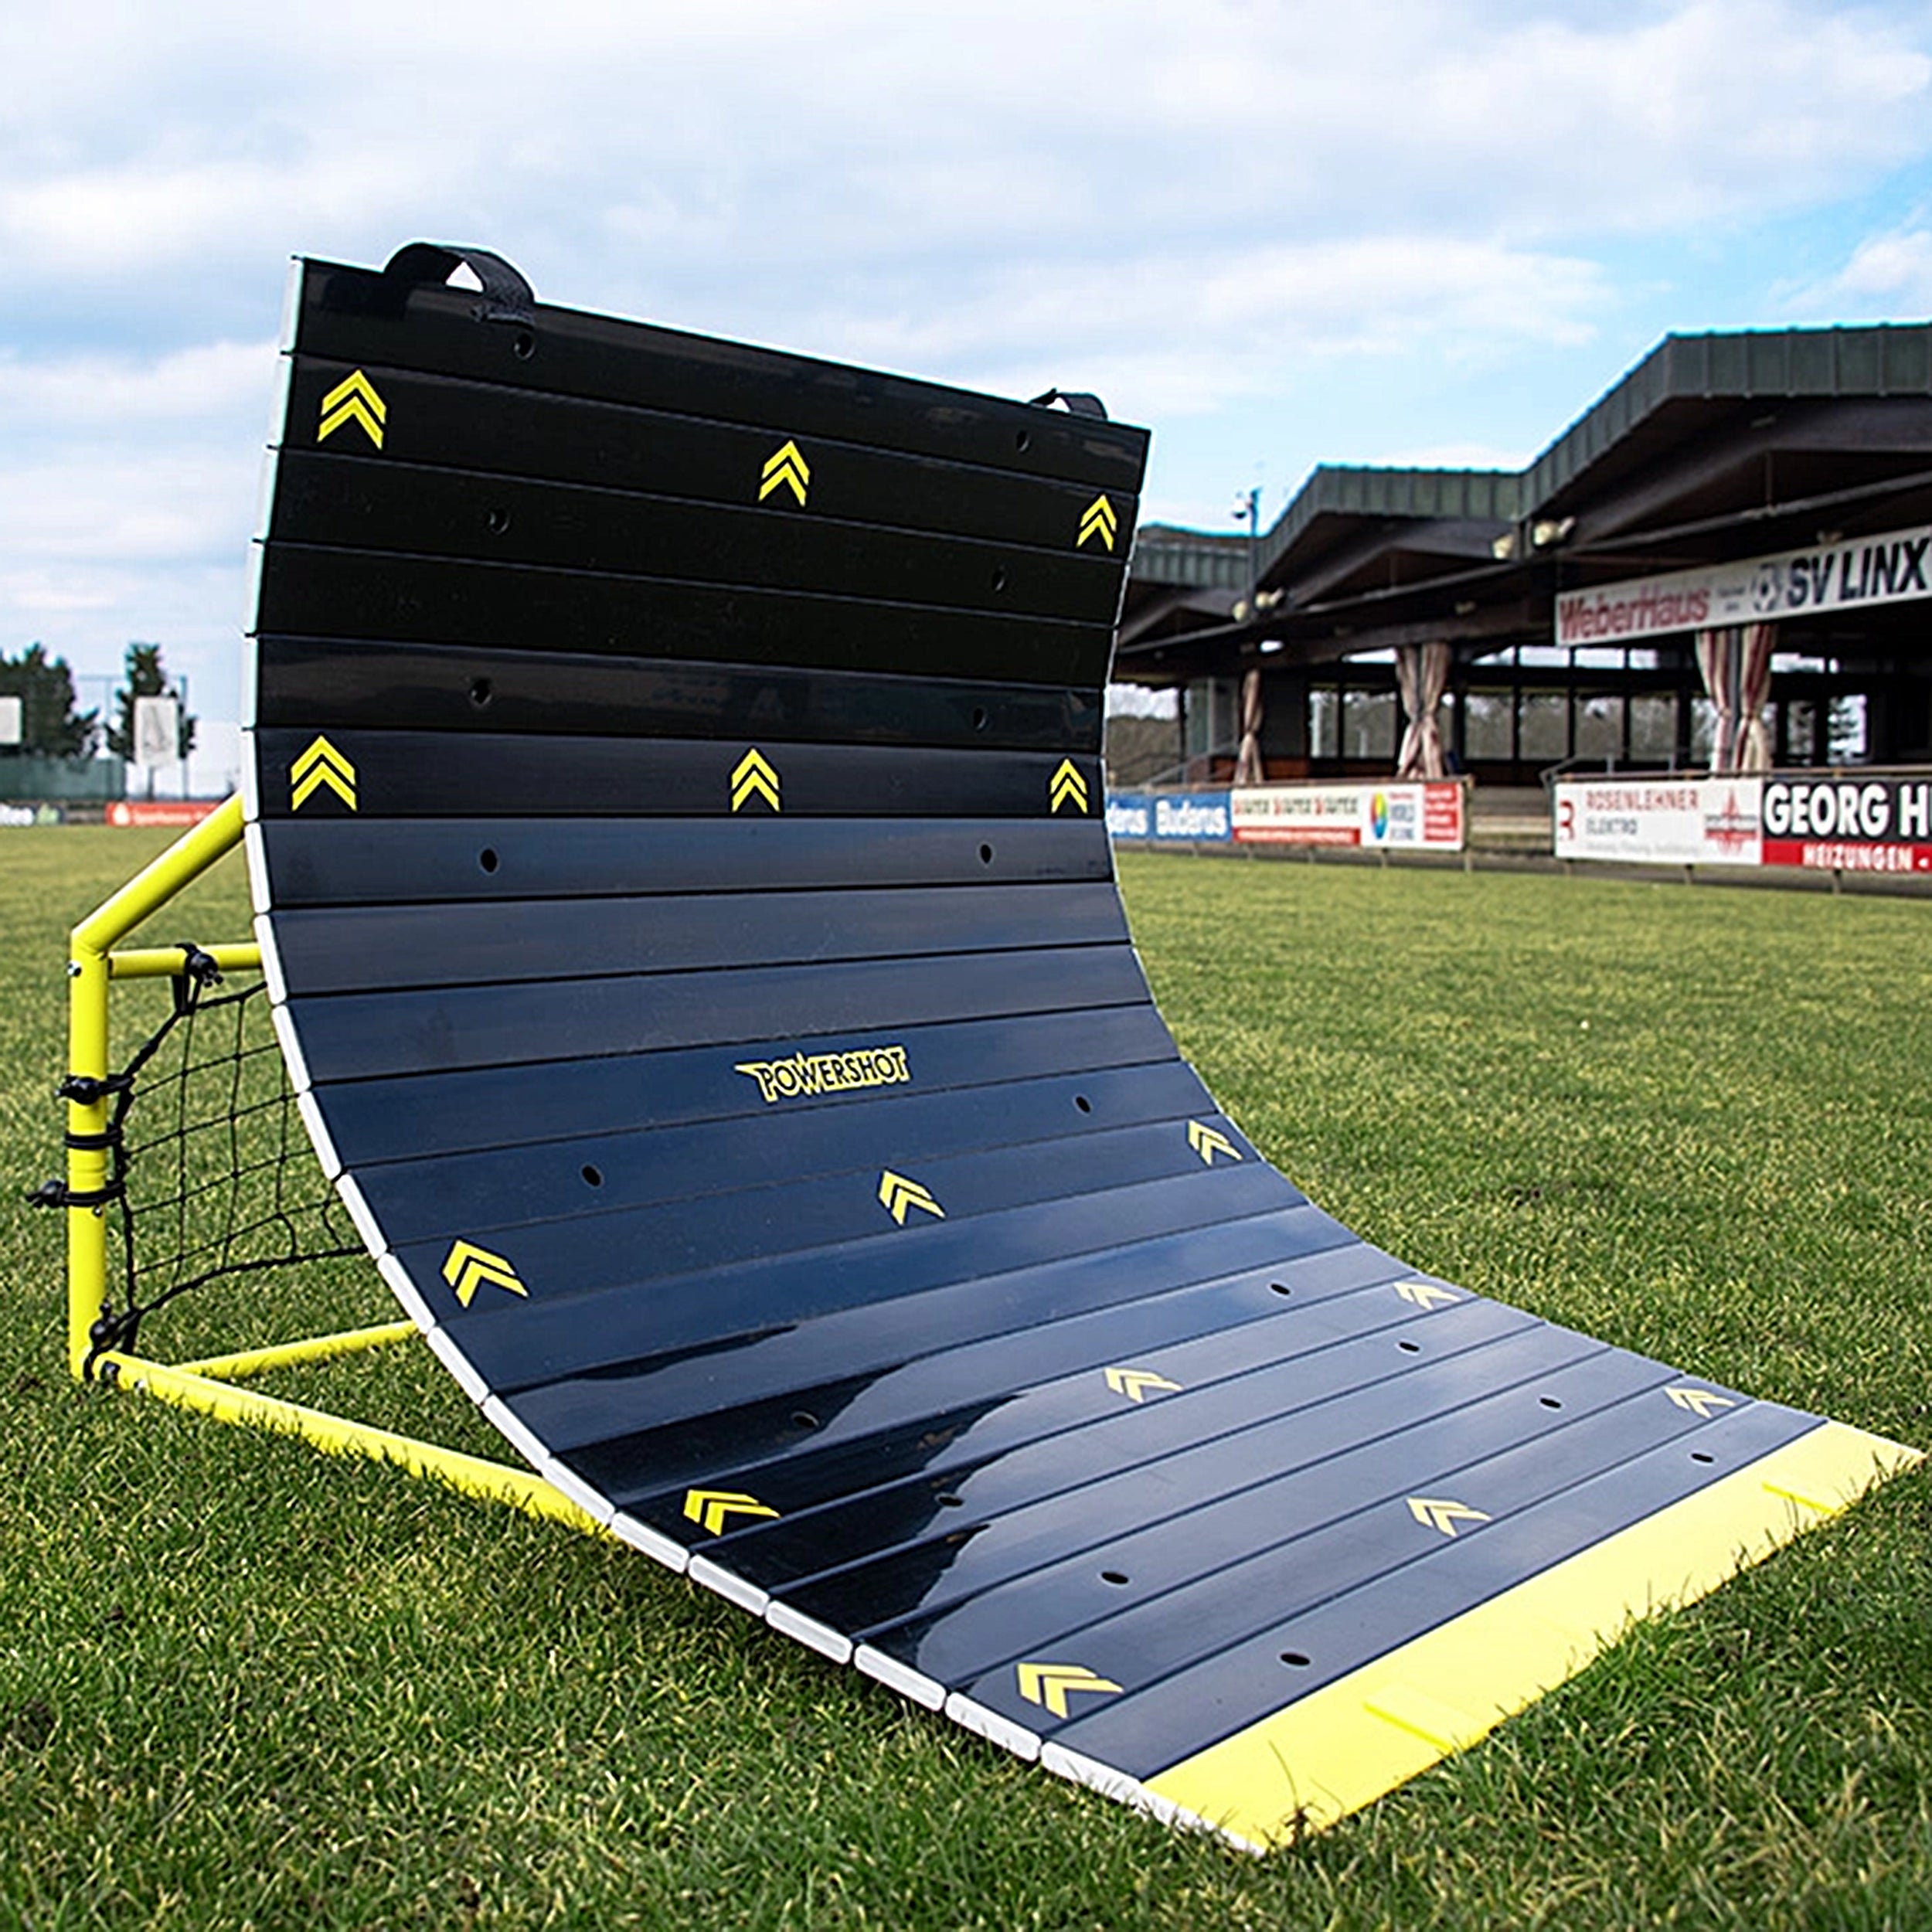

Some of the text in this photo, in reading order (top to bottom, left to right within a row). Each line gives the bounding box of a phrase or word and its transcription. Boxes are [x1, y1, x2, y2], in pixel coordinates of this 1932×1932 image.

[1787, 537, 1930, 607] SV LINX
[1559, 582, 1711, 641] WeberHaus
[1764, 783, 1932, 837] GEORG H
[1802, 843, 1913, 871] HEIZUNGEN
[738, 1046, 910, 1102] POWERSHOT
